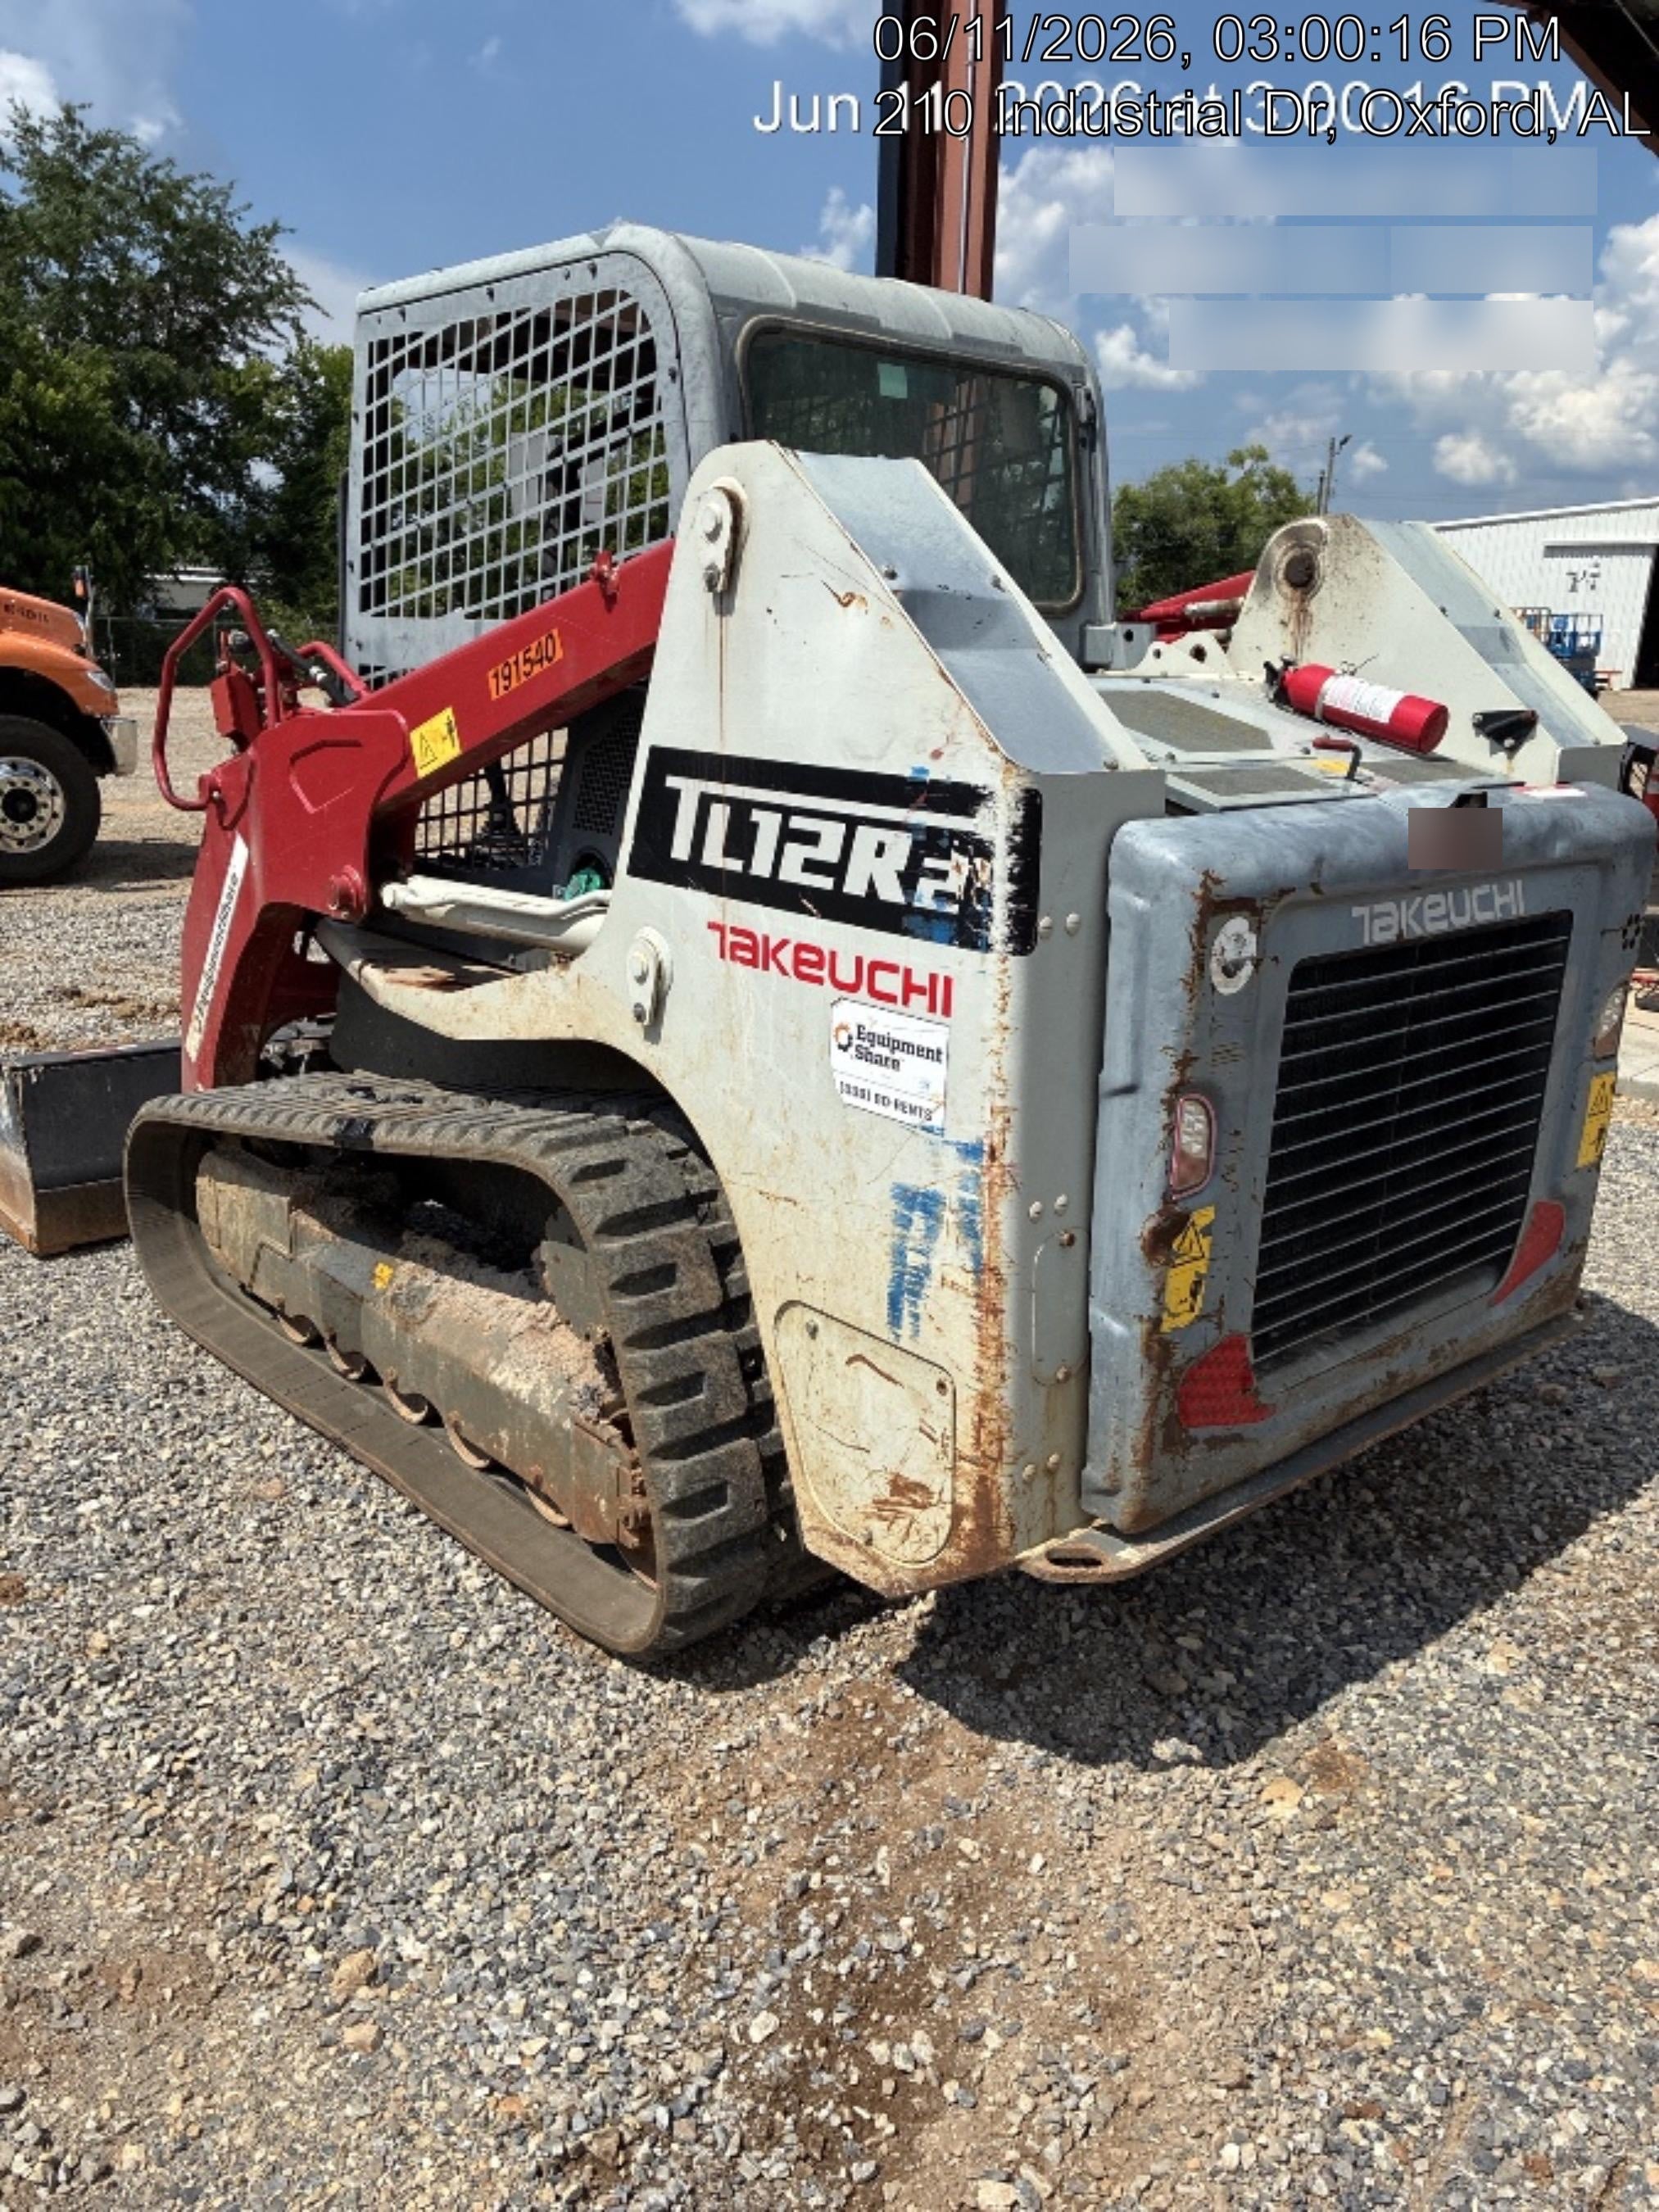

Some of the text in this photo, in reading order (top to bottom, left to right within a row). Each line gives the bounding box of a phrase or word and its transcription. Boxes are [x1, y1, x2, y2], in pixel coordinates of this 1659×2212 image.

[492, 632, 556, 696] 191540
[854, 1043, 901, 1072] Share
[855, 1024, 944, 1064] Equipment
